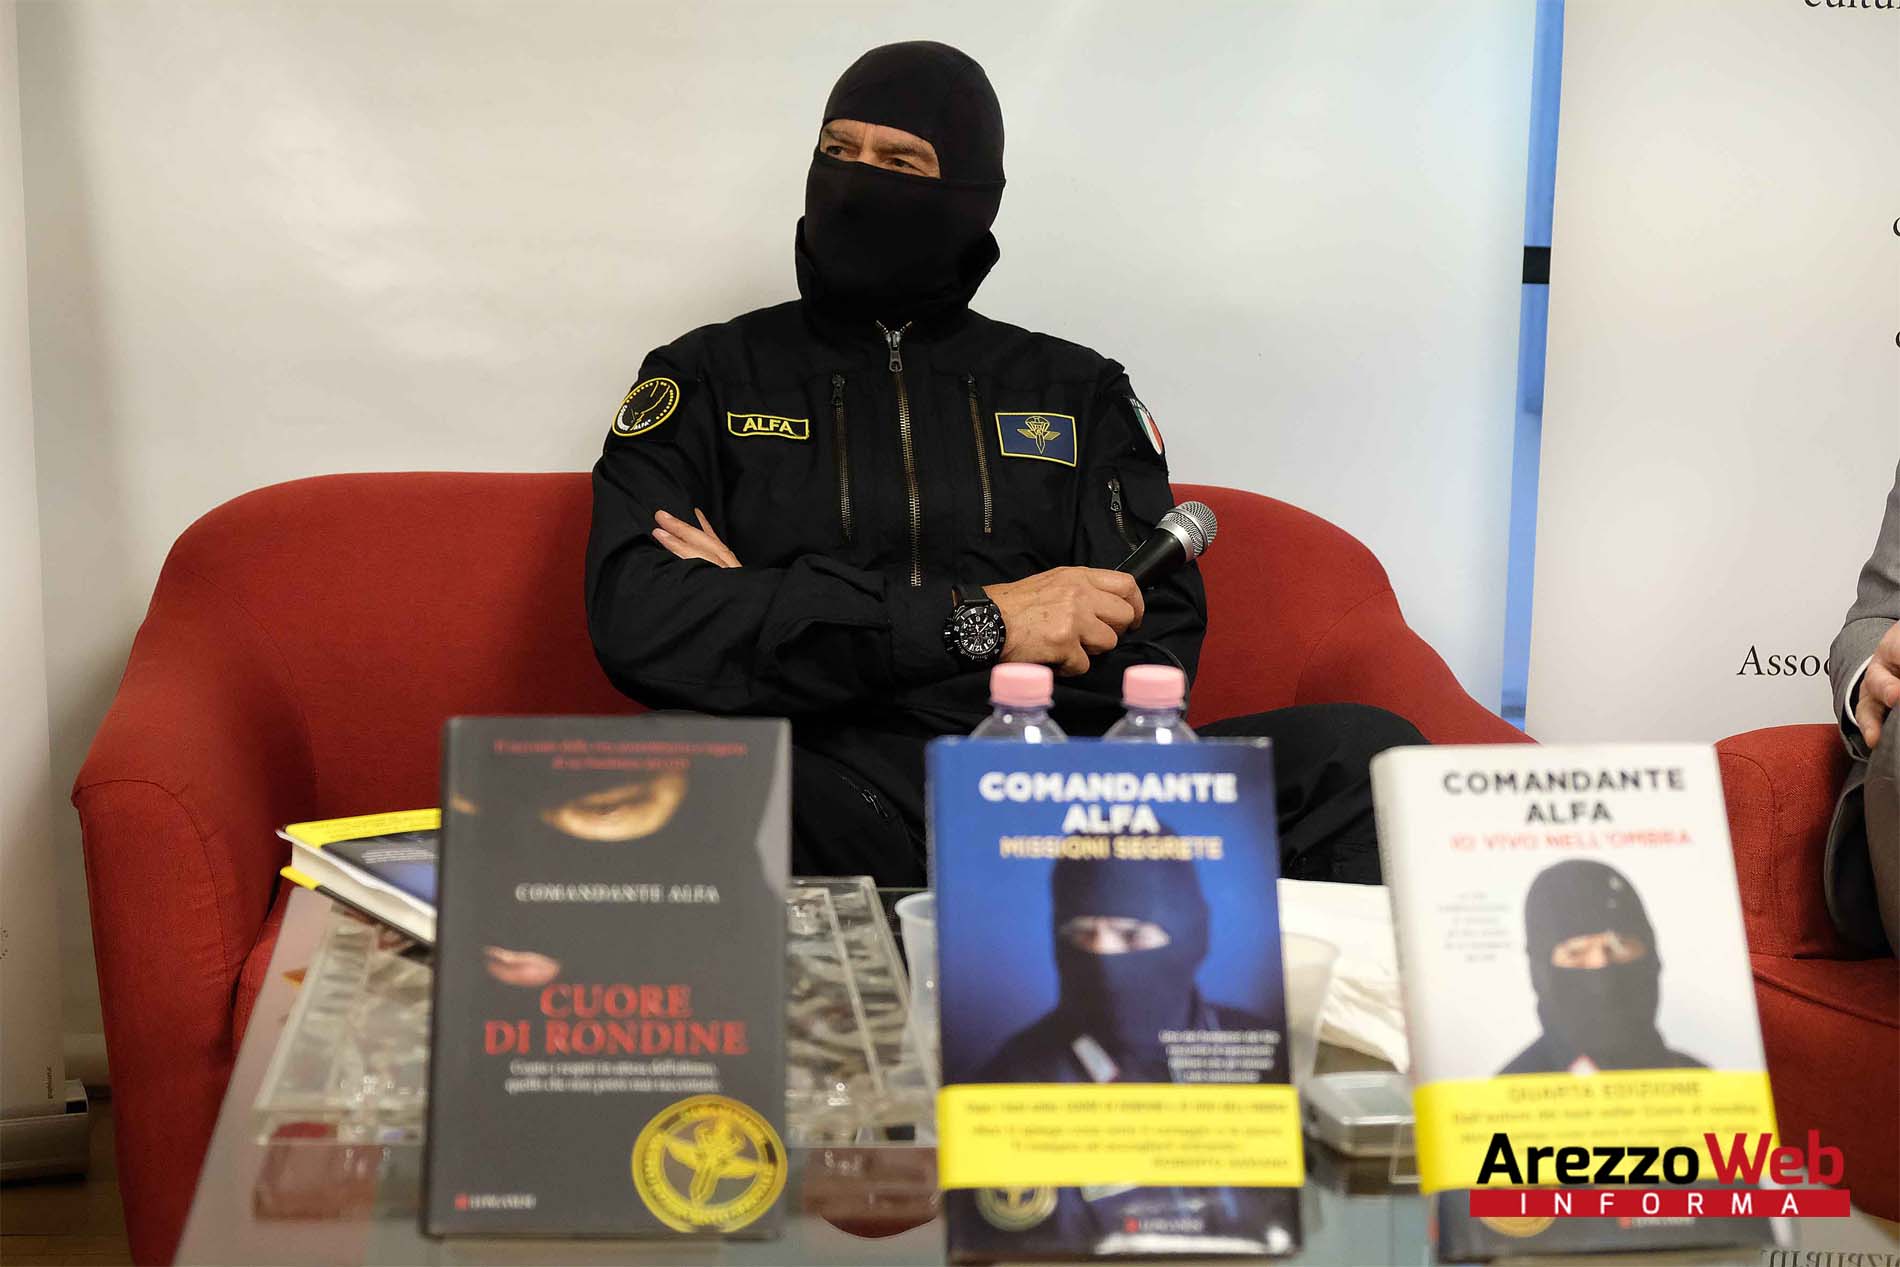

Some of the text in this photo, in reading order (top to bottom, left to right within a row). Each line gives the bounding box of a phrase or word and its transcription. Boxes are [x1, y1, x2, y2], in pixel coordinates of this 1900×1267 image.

[743, 417, 793, 434] ALFA
[979, 770, 1239, 803] COMANDANTE
[1441, 768, 1686, 796] COMANDANTE
[1061, 803, 1161, 835] ALFA
[1525, 801, 1614, 824] ALFA
[1000, 835, 1224, 860] MISSIONI SEGRETE
[1483, 833, 1539, 850] VIVO
[514, 882, 721, 904] COMANDANTE ALFA
[539, 983, 693, 1018] CUORE
[484, 1020, 750, 1056] DI RONDINE
[1602, 1081, 1701, 1098] EDIZIONE
